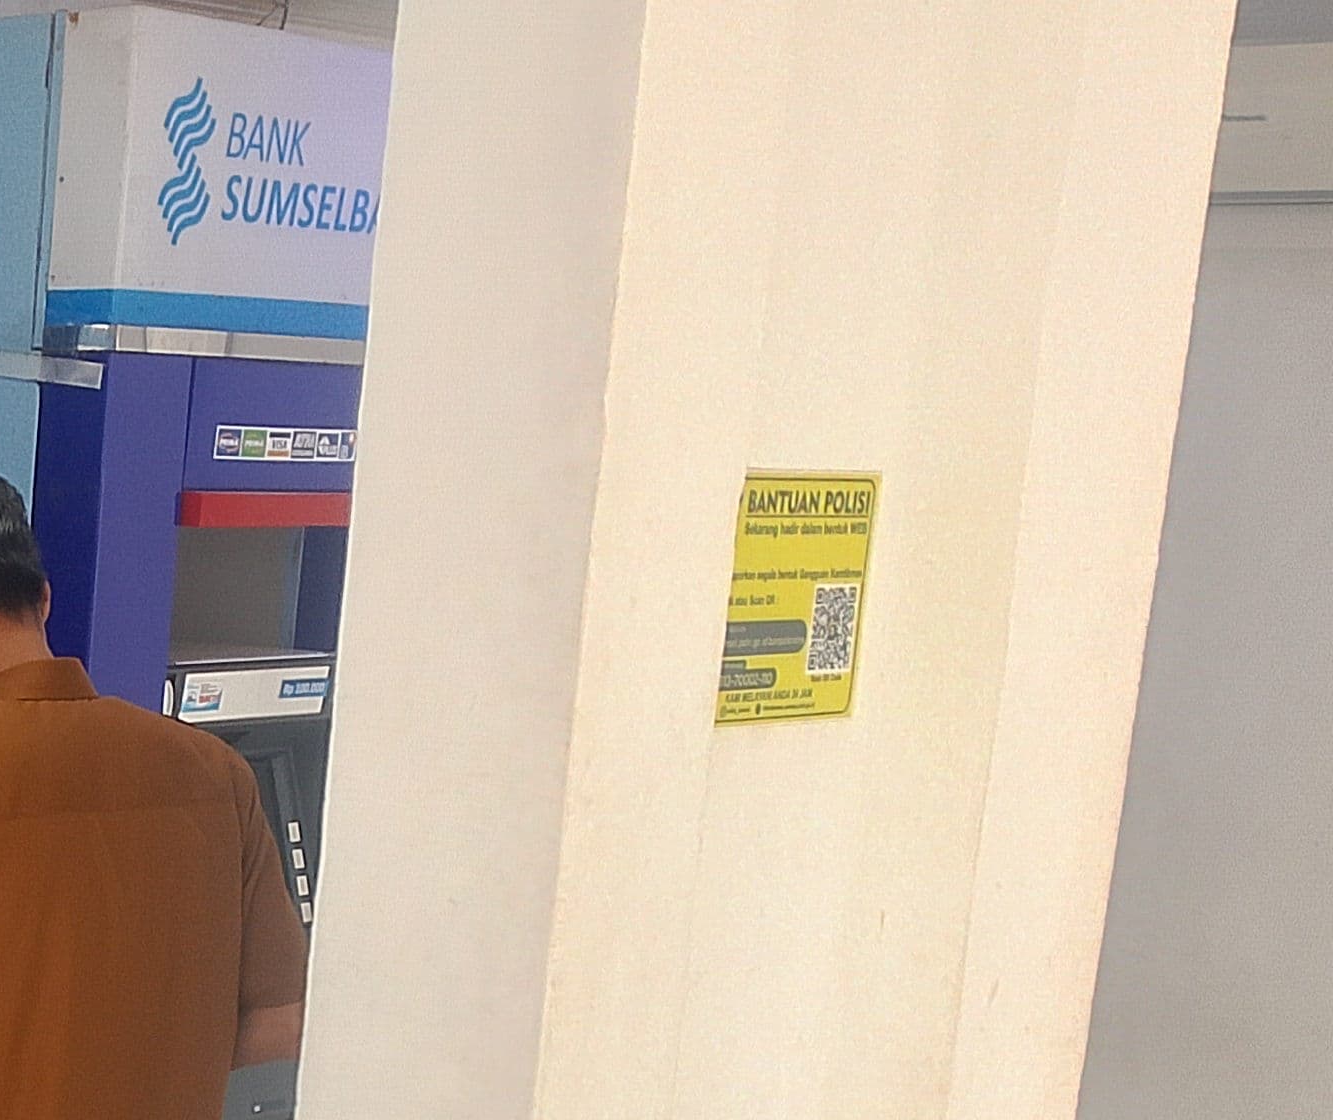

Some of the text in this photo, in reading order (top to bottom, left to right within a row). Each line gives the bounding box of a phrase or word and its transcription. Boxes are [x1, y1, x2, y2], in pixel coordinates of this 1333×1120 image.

[226, 112, 311, 166] BANK
[747, 489, 871, 514] BANTUAN POLISI
